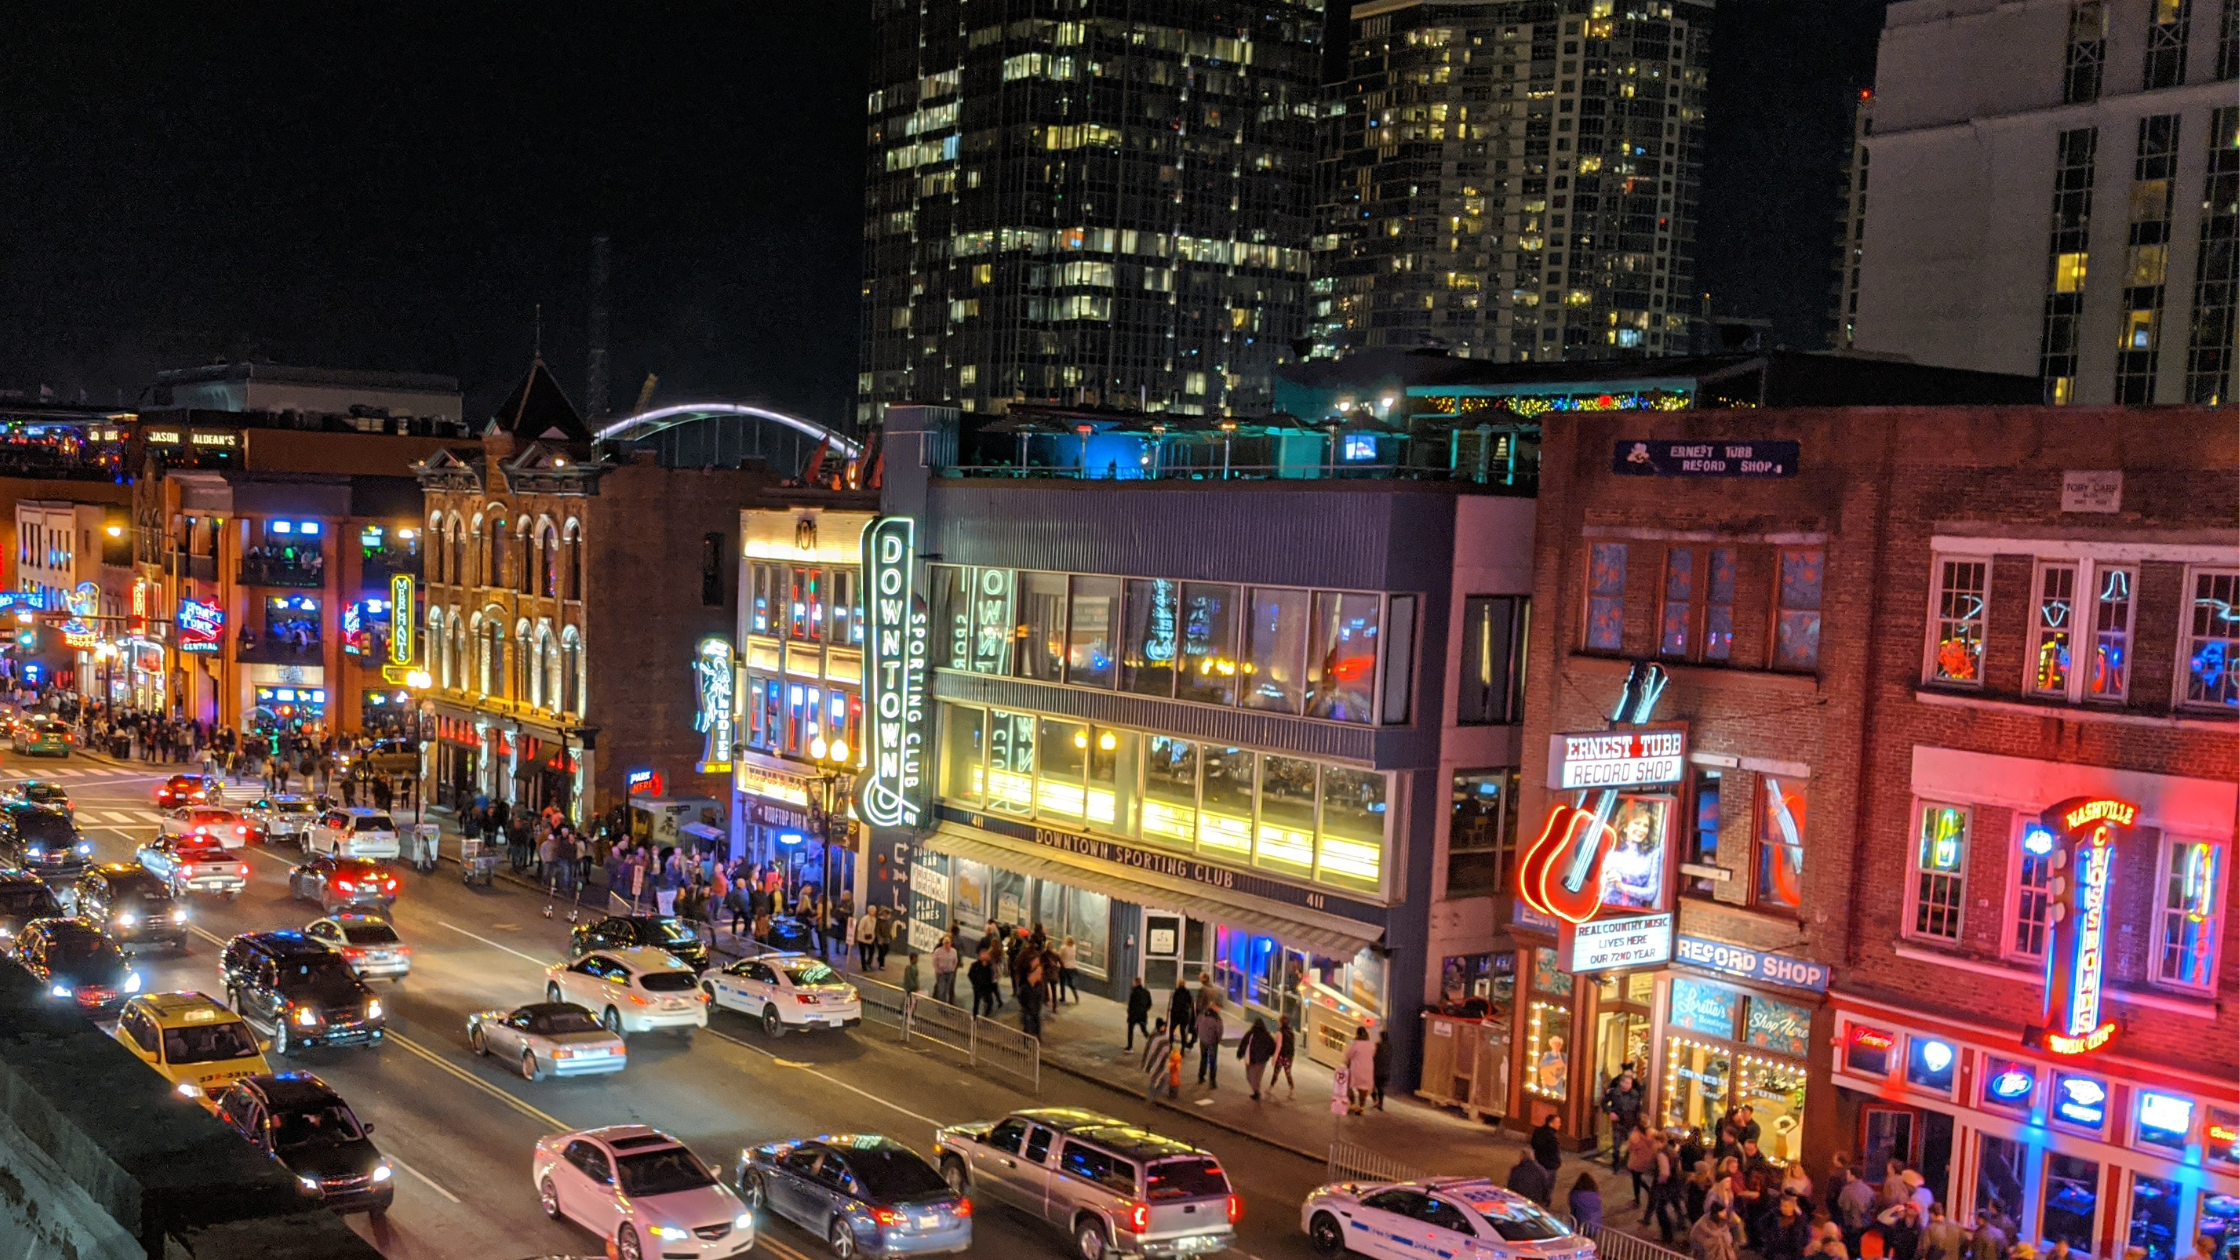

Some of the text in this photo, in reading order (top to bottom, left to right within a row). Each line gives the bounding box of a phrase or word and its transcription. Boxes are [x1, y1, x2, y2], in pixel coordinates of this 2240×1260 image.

[149, 432, 235, 446] JASON ALDEAN'S
[1670, 445, 1753, 458] ERNEST TUBB
[1683, 460, 1726, 472] RECORD
[1740, 461, 1772, 472] SHOP
[396, 580, 407, 661] MERCHANTS
[880, 536, 902, 778] DOWNTOWN
[904, 614, 925, 788] SPORTING CLUB
[1566, 733, 1681, 760] ERNEST TUBB
[630, 771, 651, 785] PARK
[1573, 760, 1672, 785] RECORD SHOP
[632, 780, 652, 794] HERE
[764, 805, 789, 827] ROOFTOP
[791, 811, 802, 829] BAR
[904, 811, 917, 825] 411
[971, 815, 984, 828] 411
[2066, 800, 2134, 830] NASHVILLE
[923, 857, 937, 867] BAR
[1036, 828, 1234, 889] DOWNTOWN SPORTING CLUB
[916, 900, 935, 911] PLAY
[1306, 894, 1324, 909] 411
[916, 910, 940, 920] GAMES
[1578, 917, 1668, 937] REAL COUNTRY MUSIC
[2079, 826, 2106, 1033] CROSSROADS
[1599, 935, 1648, 948] LIVES HERE
[1590, 948, 1655, 964] OUR 72ND YEAR
[1677, 939, 1821, 986] RECORD SHOP
[1678, 986, 1726, 1019] Loretta's
[1698, 1015, 1733, 1031] Boutique
[1749, 1012, 1809, 1039] Shop Here
